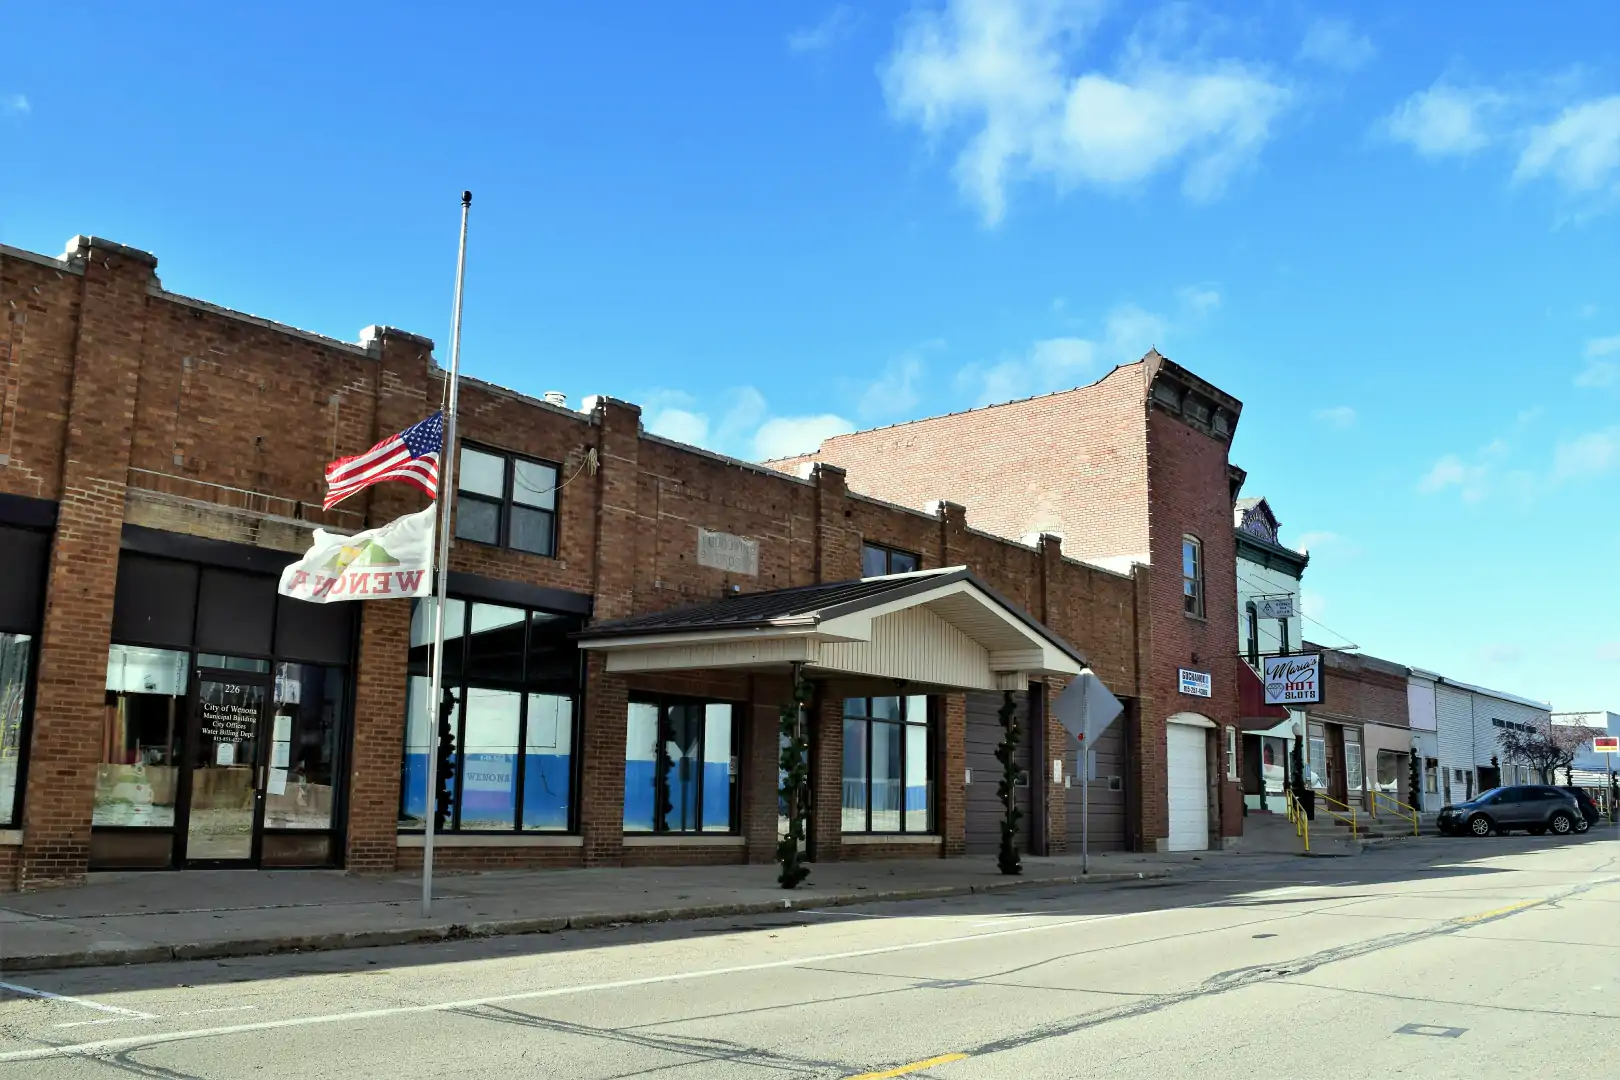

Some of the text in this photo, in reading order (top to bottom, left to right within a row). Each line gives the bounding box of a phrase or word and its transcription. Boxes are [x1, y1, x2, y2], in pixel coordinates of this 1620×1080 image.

[1266, 658, 1317, 683] Maria's
[225, 684, 241, 694] 226
[1285, 681, 1315, 691] HOT
[1285, 690, 1316, 700] SLOTS
[204, 702, 257, 715] City of Wenona
[203, 712, 257, 724] Municipal Building
[212, 720, 247, 730] City Offices
[202, 727, 255, 739] Water Billing Dept.
[466, 772, 512, 783] WENONA
